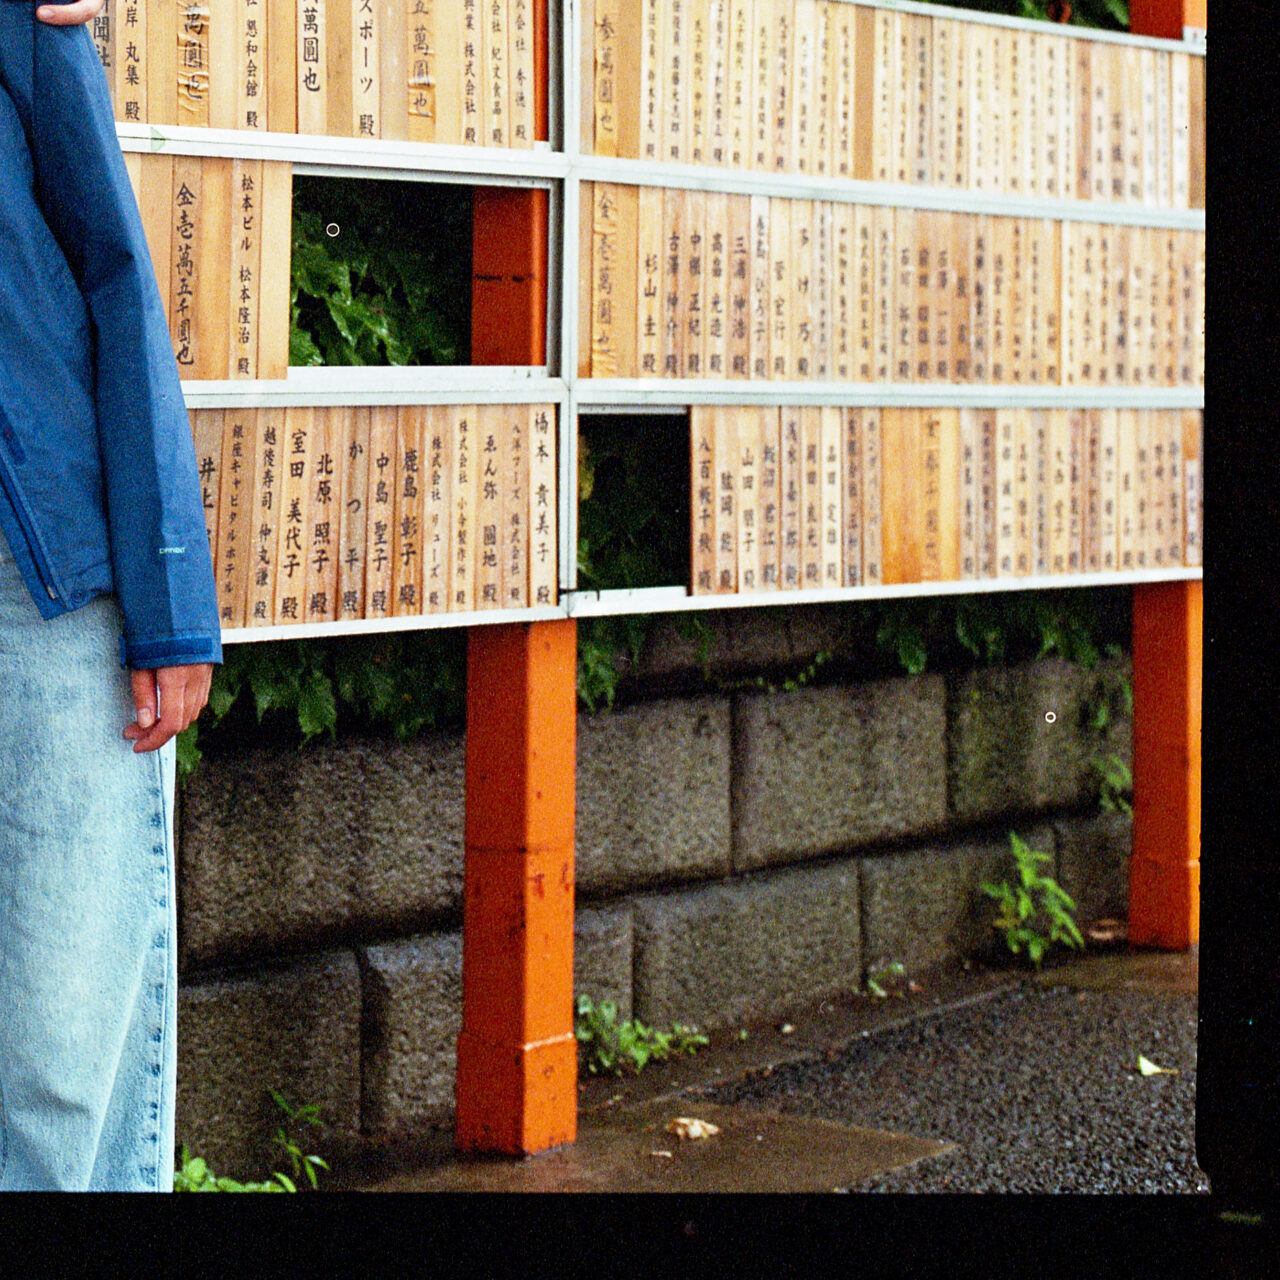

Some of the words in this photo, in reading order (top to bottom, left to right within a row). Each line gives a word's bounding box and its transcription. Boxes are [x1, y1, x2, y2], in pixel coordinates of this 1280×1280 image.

[464, 42, 476, 114] 株式会社
[125, 101, 141, 121] 殿
[359, 114, 375, 136] 殿
[240, 173, 254, 252] 松本ビル
[290, 429, 308, 479] 室田
[315, 454, 334, 505] 北原
[374, 452, 390, 504] 中島
[403, 448, 418, 499] 鹿島
[431, 436, 442, 501] 株式会社
[345, 440, 364, 572] かつ平
[283, 497, 302, 578] 美代子
[312, 521, 331, 574] 照子
[372, 521, 388, 572] 聖子
[281, 596, 298, 619] 殿
[310, 592, 328, 615] 殿
[343, 590, 358, 612] 殿
[371, 591, 387, 612] 殿
[399, 584, 415, 606] 殿
[536, 585, 550, 605] 殿
